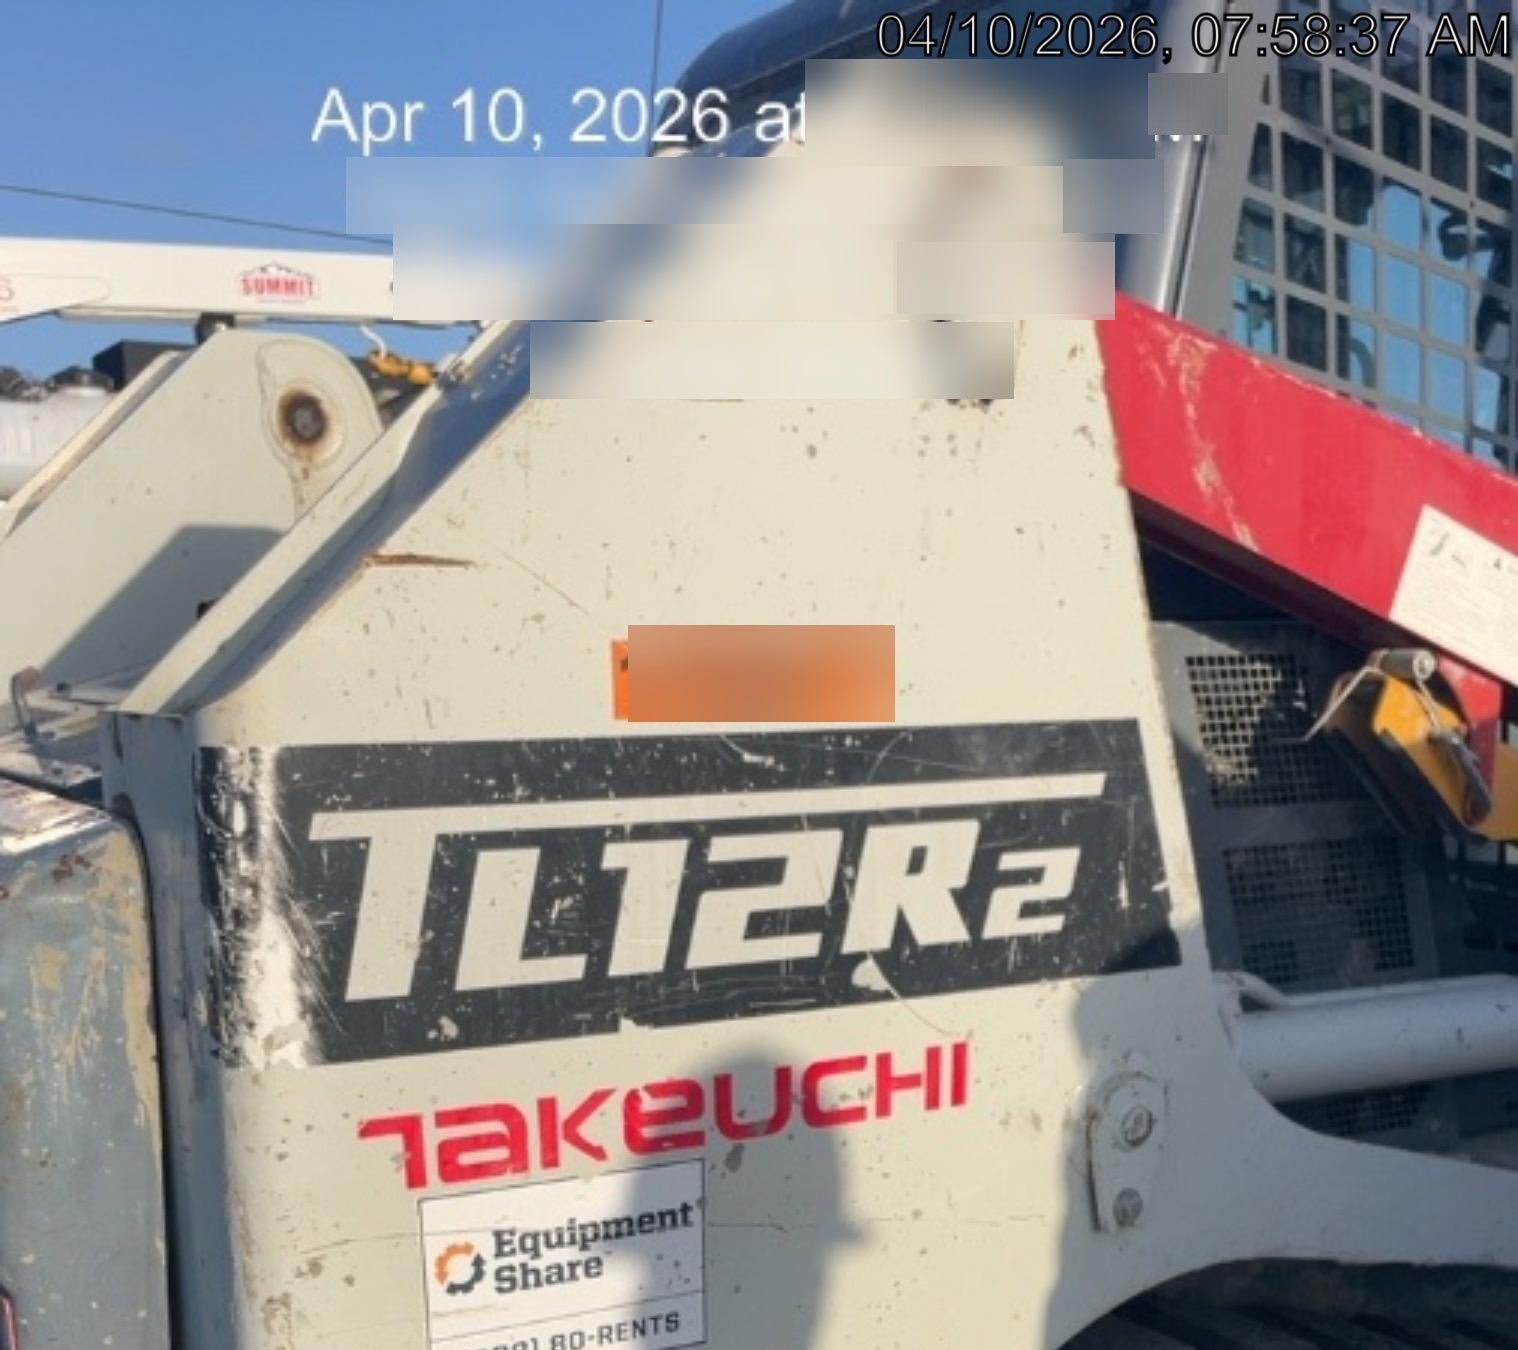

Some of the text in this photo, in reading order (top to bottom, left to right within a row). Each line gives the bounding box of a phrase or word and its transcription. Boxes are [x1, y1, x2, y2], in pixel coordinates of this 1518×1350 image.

[241, 277, 314, 297] SUMMIT
[309, 772, 1106, 1002] TL12R2
[491, 1202, 694, 1261] Equipment
[493, 1254, 604, 1295] Share
